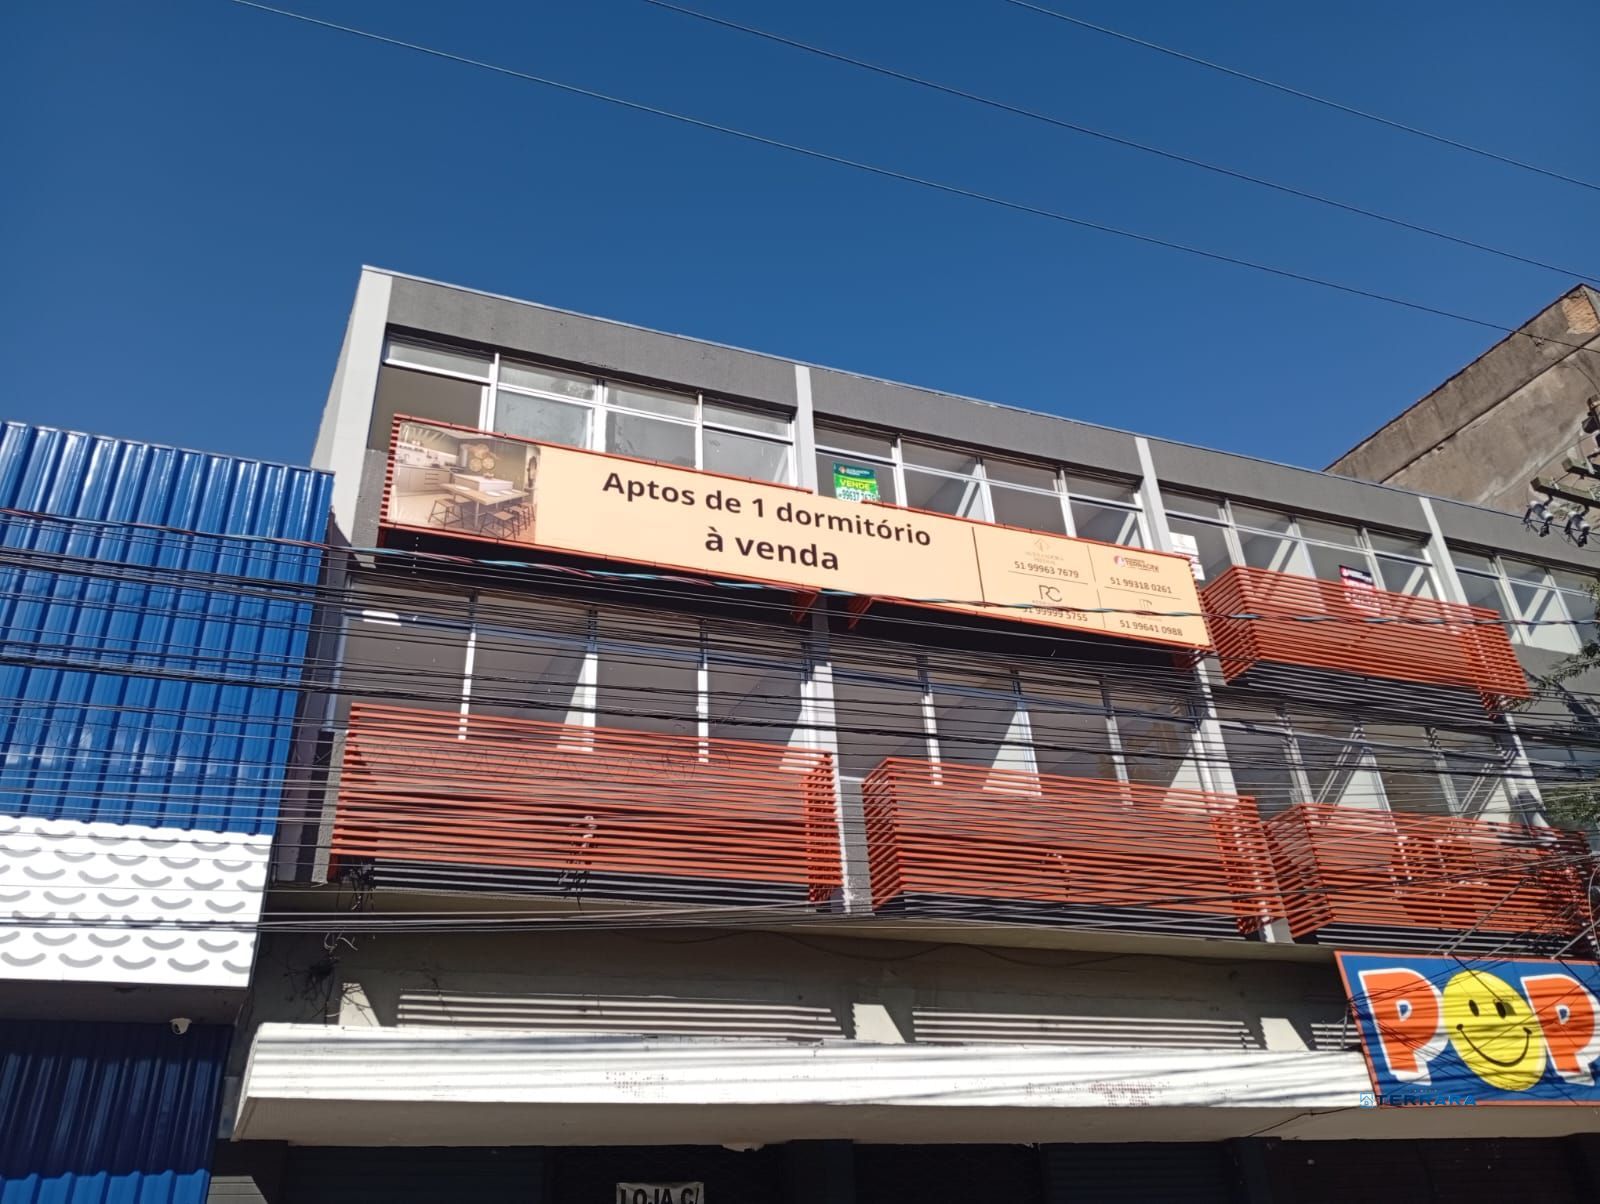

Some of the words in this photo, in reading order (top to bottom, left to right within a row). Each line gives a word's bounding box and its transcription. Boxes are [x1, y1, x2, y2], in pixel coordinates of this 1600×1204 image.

[840, 478, 870, 491] VENDE
[602, 472, 695, 506] Aptos
[705, 490, 742, 514] de
[751, 498, 764, 518] 1
[776, 502, 931, 546] dormitório
[705, 526, 724, 553] à
[735, 537, 839, 571] venda
[1014, 560, 1025, 570] 51
[1027, 563, 1056, 575] 99963
[1057, 567, 1079, 579] 7679
[1110, 576, 1121, 586] 51
[1123, 578, 1150, 591] 99318
[1151, 583, 1173, 594] 0261
[1066, 611, 1088, 622] 5755
[1119, 619, 1131, 629] 51
[1132, 621, 1159, 633] 99641
[1161, 625, 1183, 637] 0988
